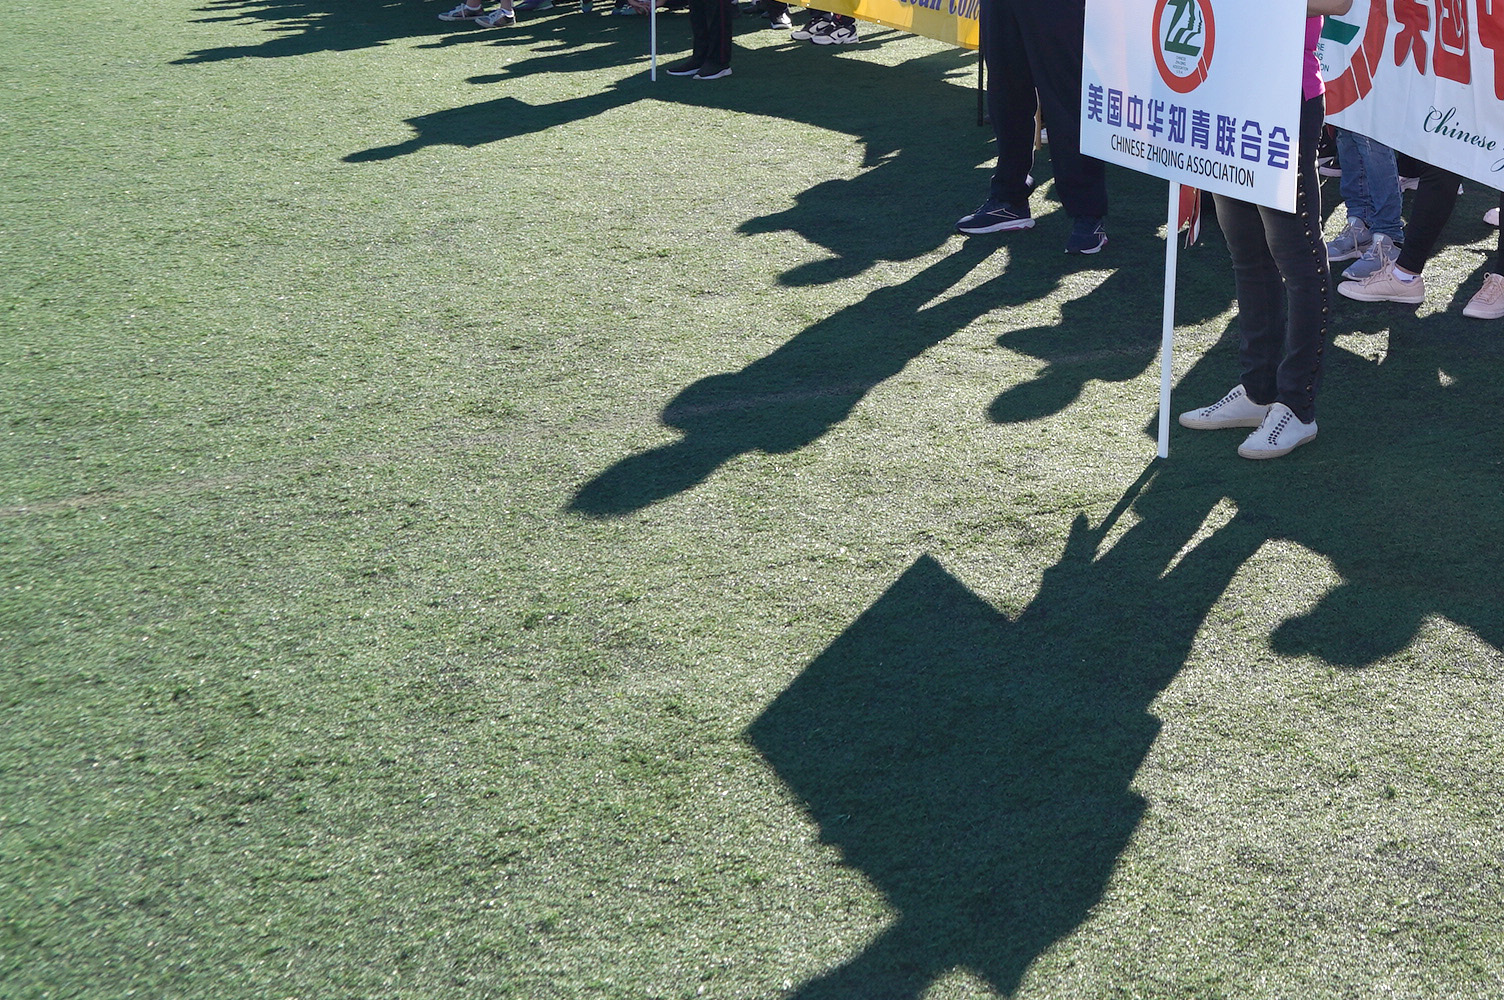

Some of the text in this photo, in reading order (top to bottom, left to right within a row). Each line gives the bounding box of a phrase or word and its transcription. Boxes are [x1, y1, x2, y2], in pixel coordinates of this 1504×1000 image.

[1087, 83, 1291, 170] 美国中华知青联合会
[1423, 105, 1497, 152] Chinese
[1110, 134, 1255, 189] CHINESE ZHIQING ASSOCIATION
